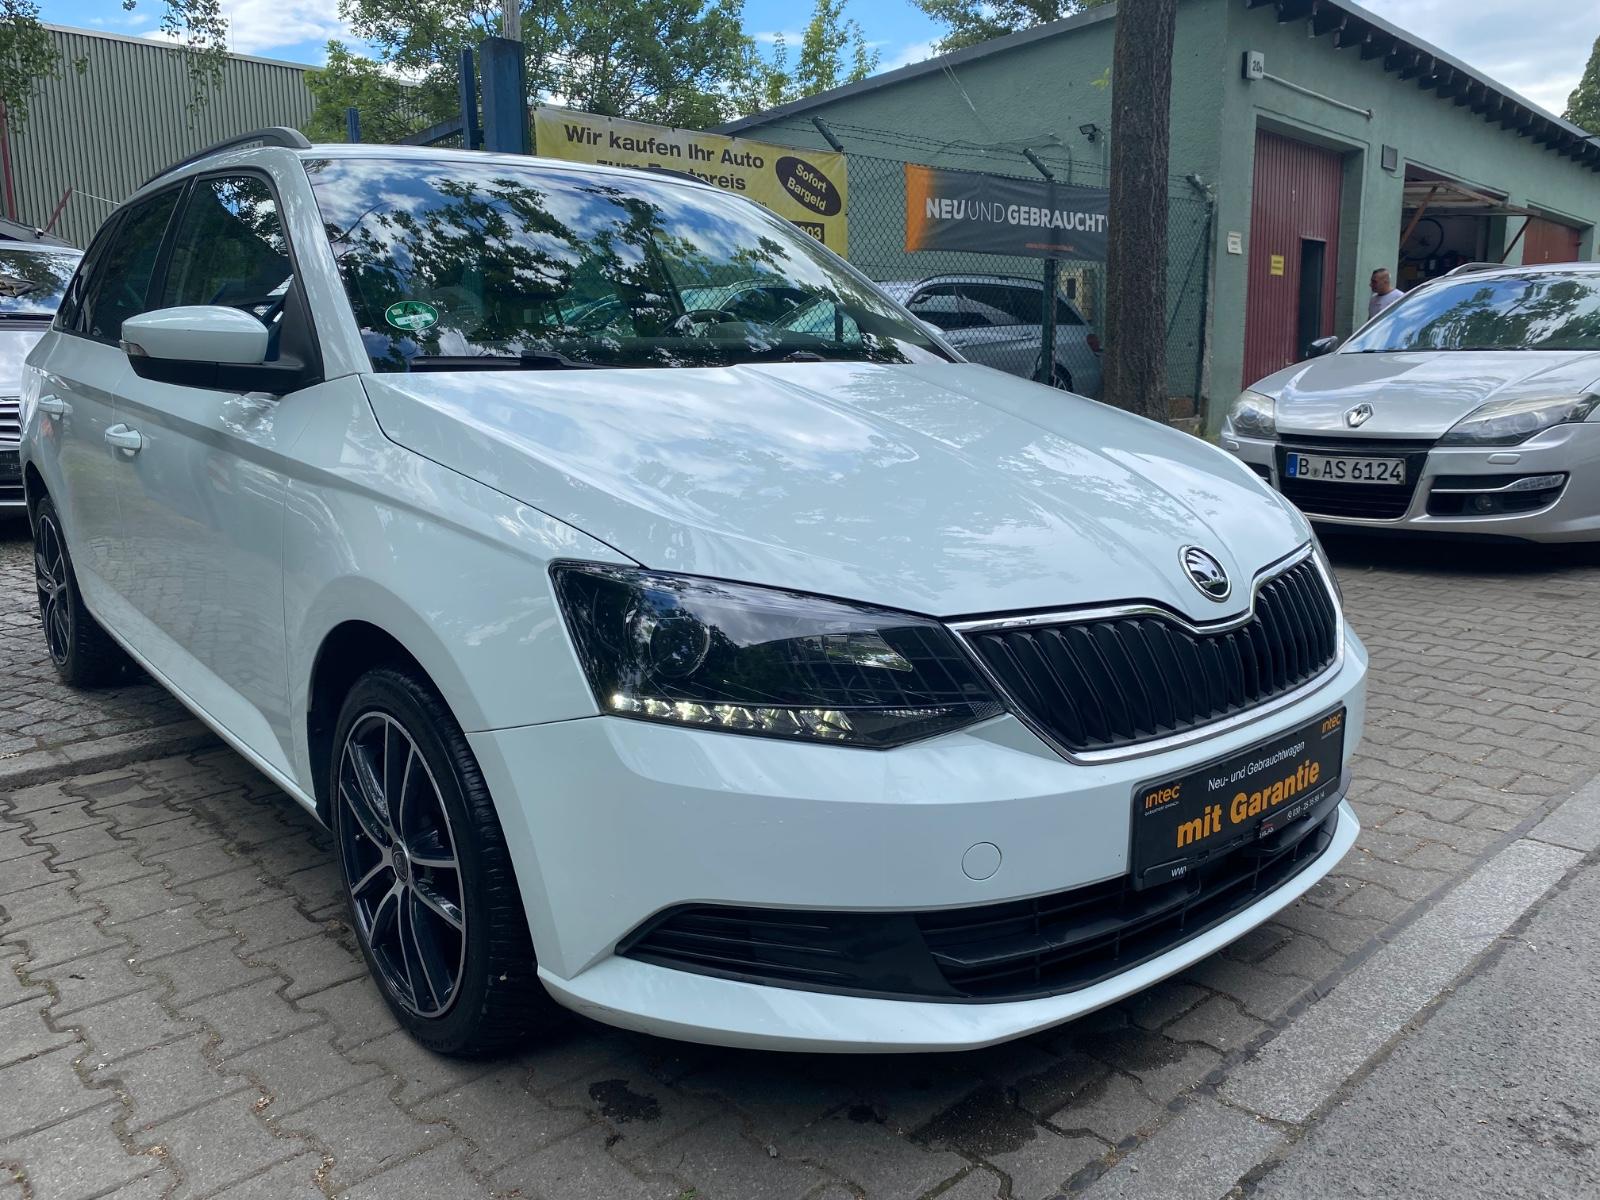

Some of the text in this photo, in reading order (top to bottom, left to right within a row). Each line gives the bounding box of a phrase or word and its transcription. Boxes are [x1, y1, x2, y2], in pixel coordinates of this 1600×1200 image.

[564, 124, 764, 170] Wir kaufen Ihr Auto
[787, 176, 827, 211] Bargeld
[795, 163, 827, 193] Sofort
[925, 197, 1109, 232] NEU UND GEBRAUCHT
[1299, 457, 1402, 482] B AS 6124
[1207, 740, 1305, 792] Neu- und Gebrauchtwagen
[1176, 759, 1320, 848] mit Garantie
